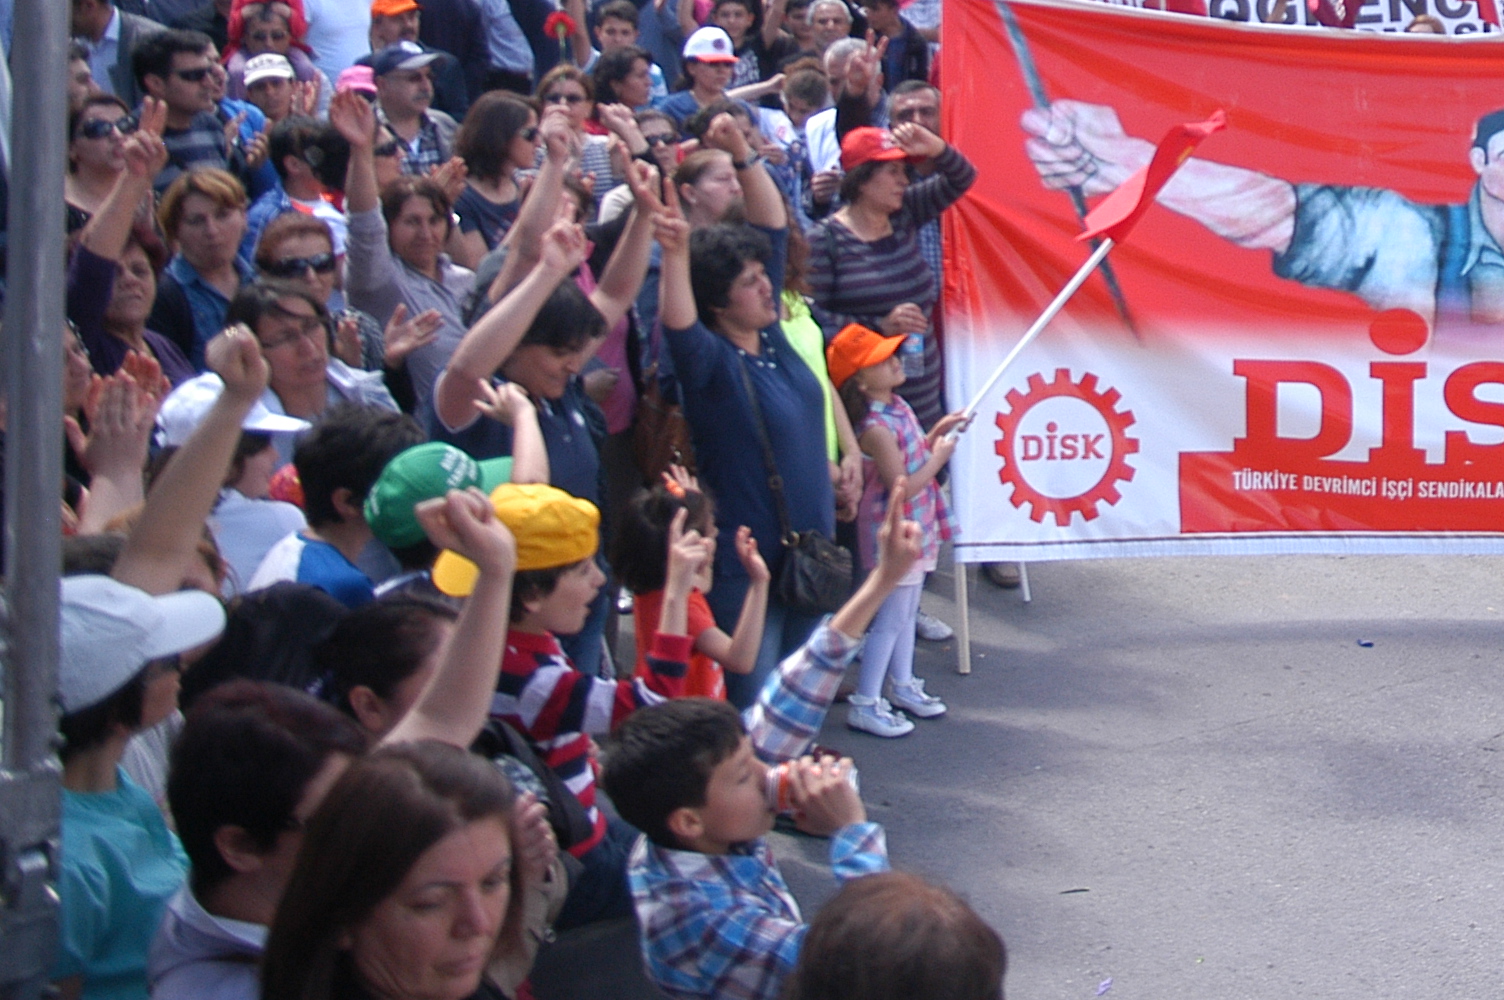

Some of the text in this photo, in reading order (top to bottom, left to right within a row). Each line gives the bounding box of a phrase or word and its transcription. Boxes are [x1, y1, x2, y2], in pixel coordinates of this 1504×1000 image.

[1021, 421, 1105, 461] DİSK
[1232, 468, 1298, 491] TÜRKİYE
[1303, 475, 1377, 497] DEVRİMCİ
[1382, 476, 1413, 500] İŞÇİ
